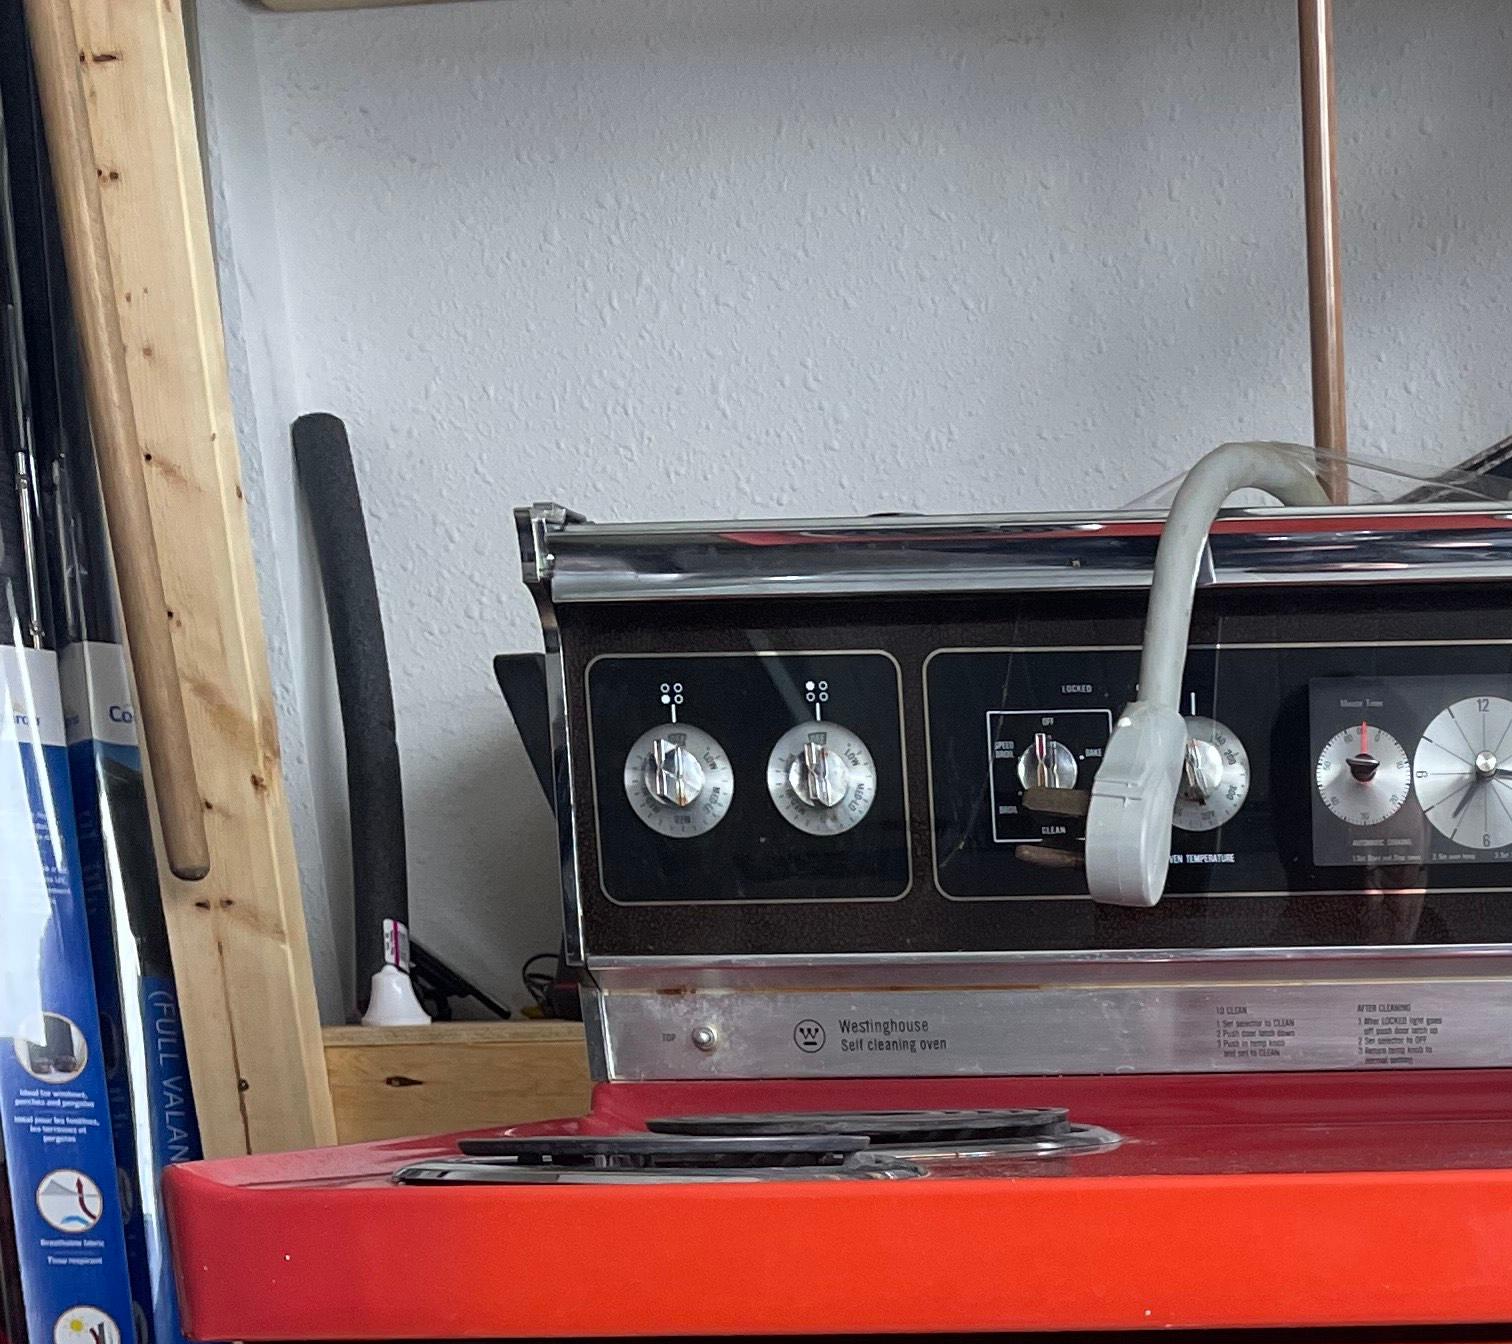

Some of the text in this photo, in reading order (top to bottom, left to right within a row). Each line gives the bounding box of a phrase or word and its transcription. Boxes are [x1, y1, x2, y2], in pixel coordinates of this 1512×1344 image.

[1476, 698, 1490, 713] 12
[1042, 826, 1066, 835] CLEAN
[1482, 833, 1491, 847] 6
[1169, 853, 1235, 864] VEN TEMPERATURE
[148, 990, 180, 1066] (FULL
[839, 1019, 929, 1036] Westinghouse
[841, 1037, 947, 1053] Self cleaning oven
